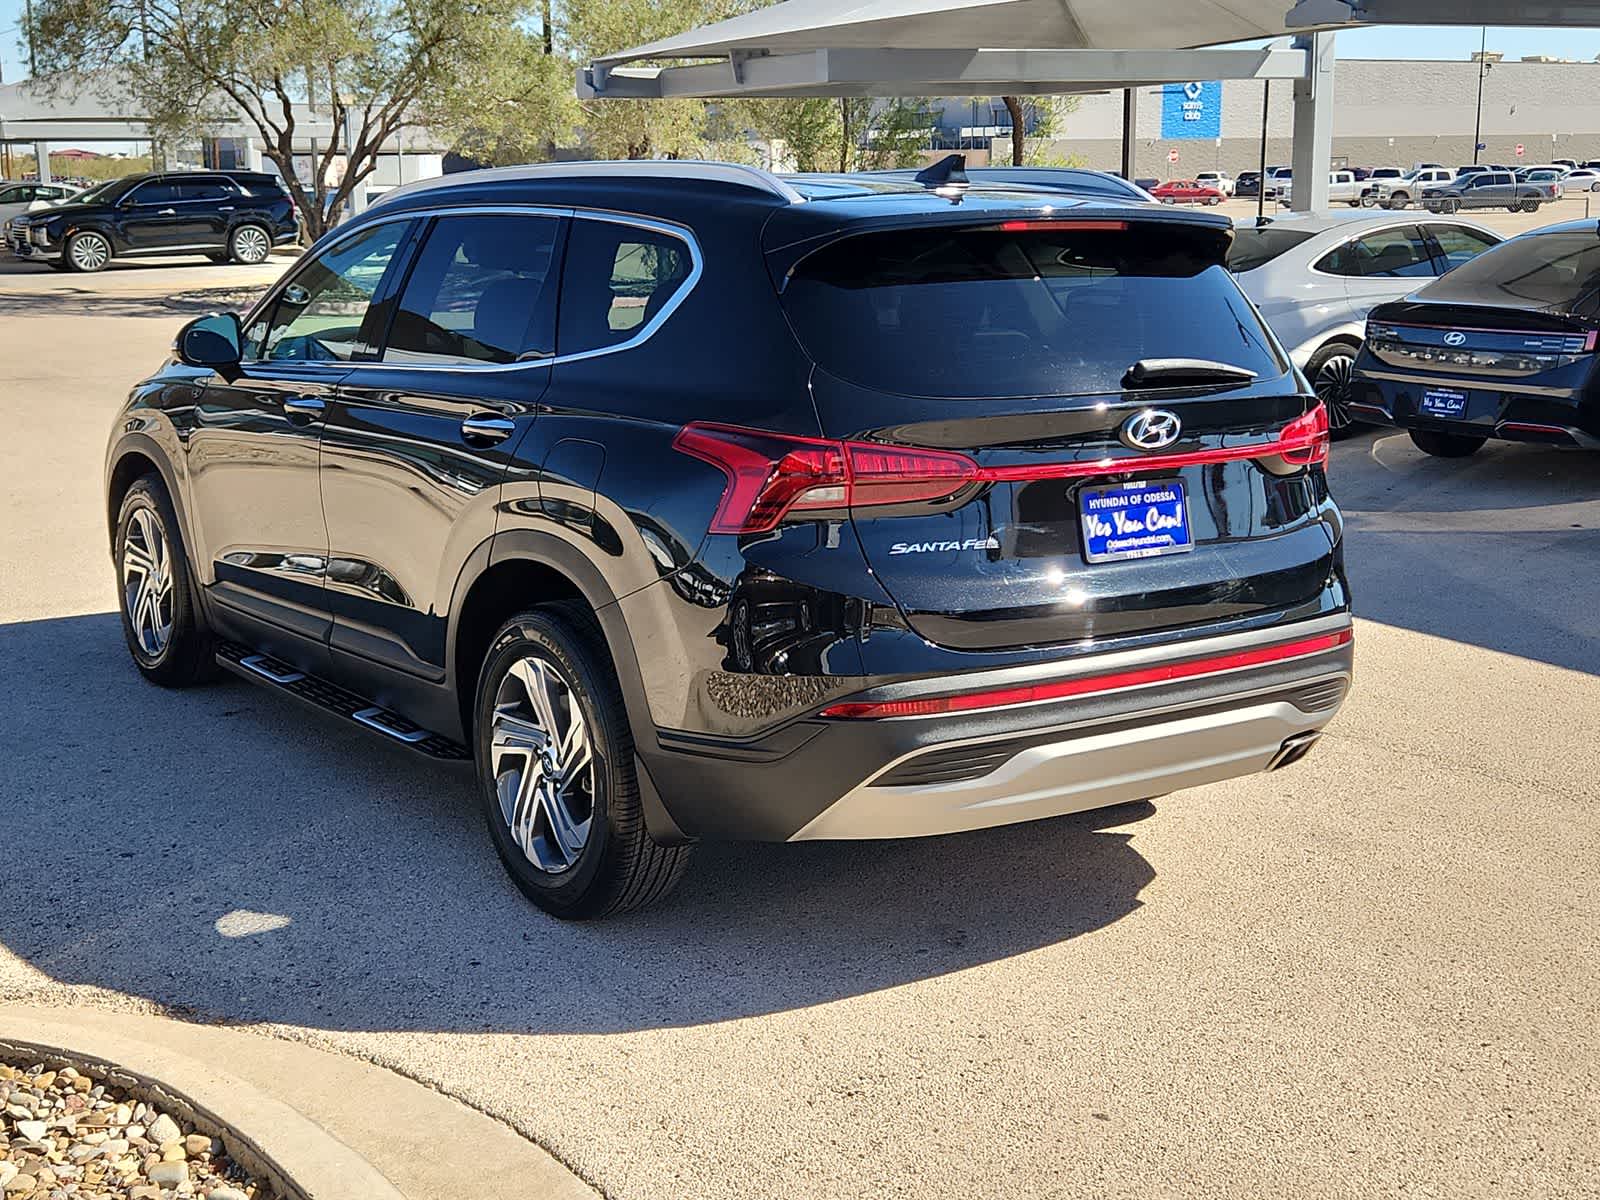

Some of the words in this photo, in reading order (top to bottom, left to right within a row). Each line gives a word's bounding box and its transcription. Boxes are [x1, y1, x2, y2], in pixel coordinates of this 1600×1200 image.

[1089, 496, 1128, 509] HYUNDAI
[1130, 494, 1142, 504] OF
[1144, 491, 1176, 503] ODESSA
[1086, 514, 1112, 538] Yes
[1113, 510, 1144, 535] You
[1146, 503, 1182, 531] Can!
